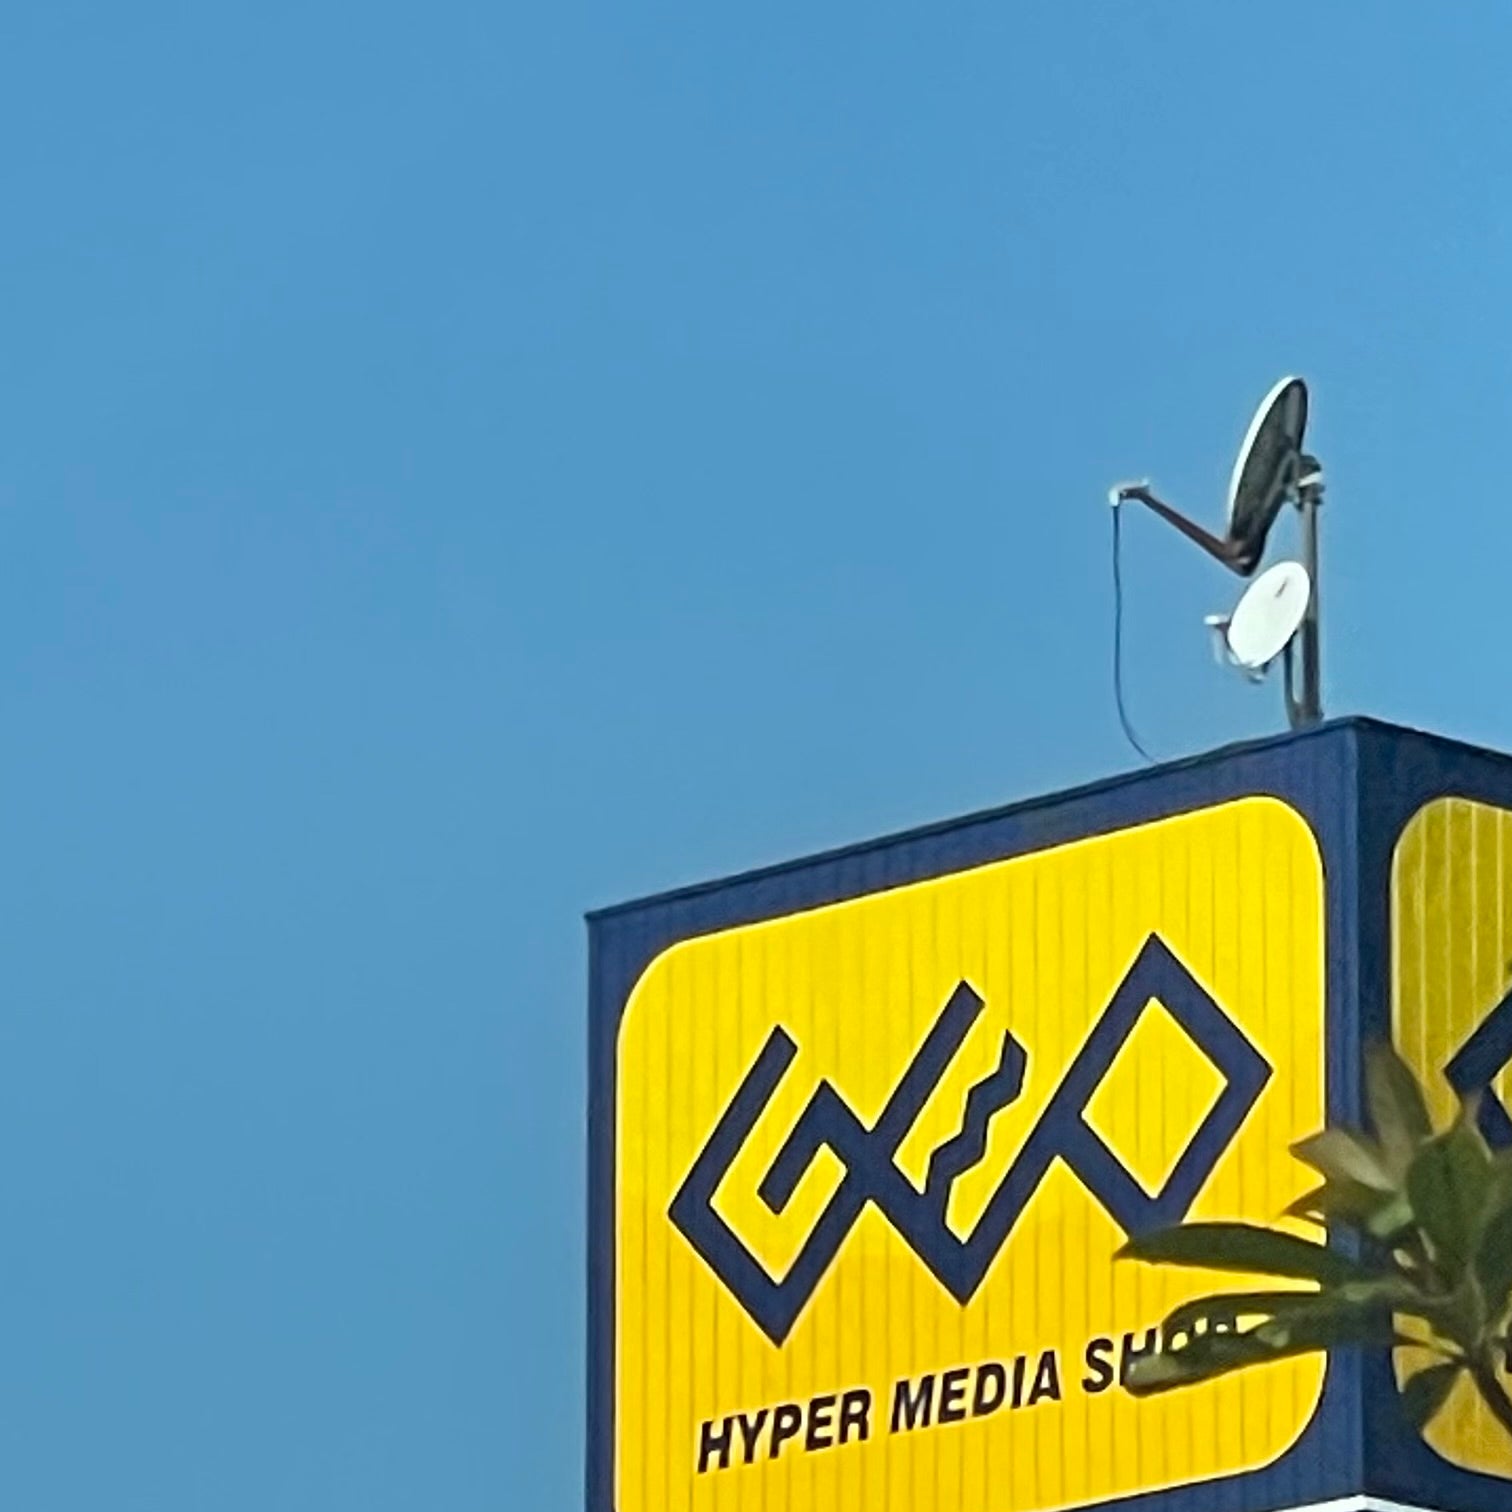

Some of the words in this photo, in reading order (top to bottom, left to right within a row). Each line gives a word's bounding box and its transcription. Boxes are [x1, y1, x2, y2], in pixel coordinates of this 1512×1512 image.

[668, 932, 1274, 1348] GEO
[696, 1390, 871, 1474] HYPER
[889, 1350, 1061, 1435] MEDIA
